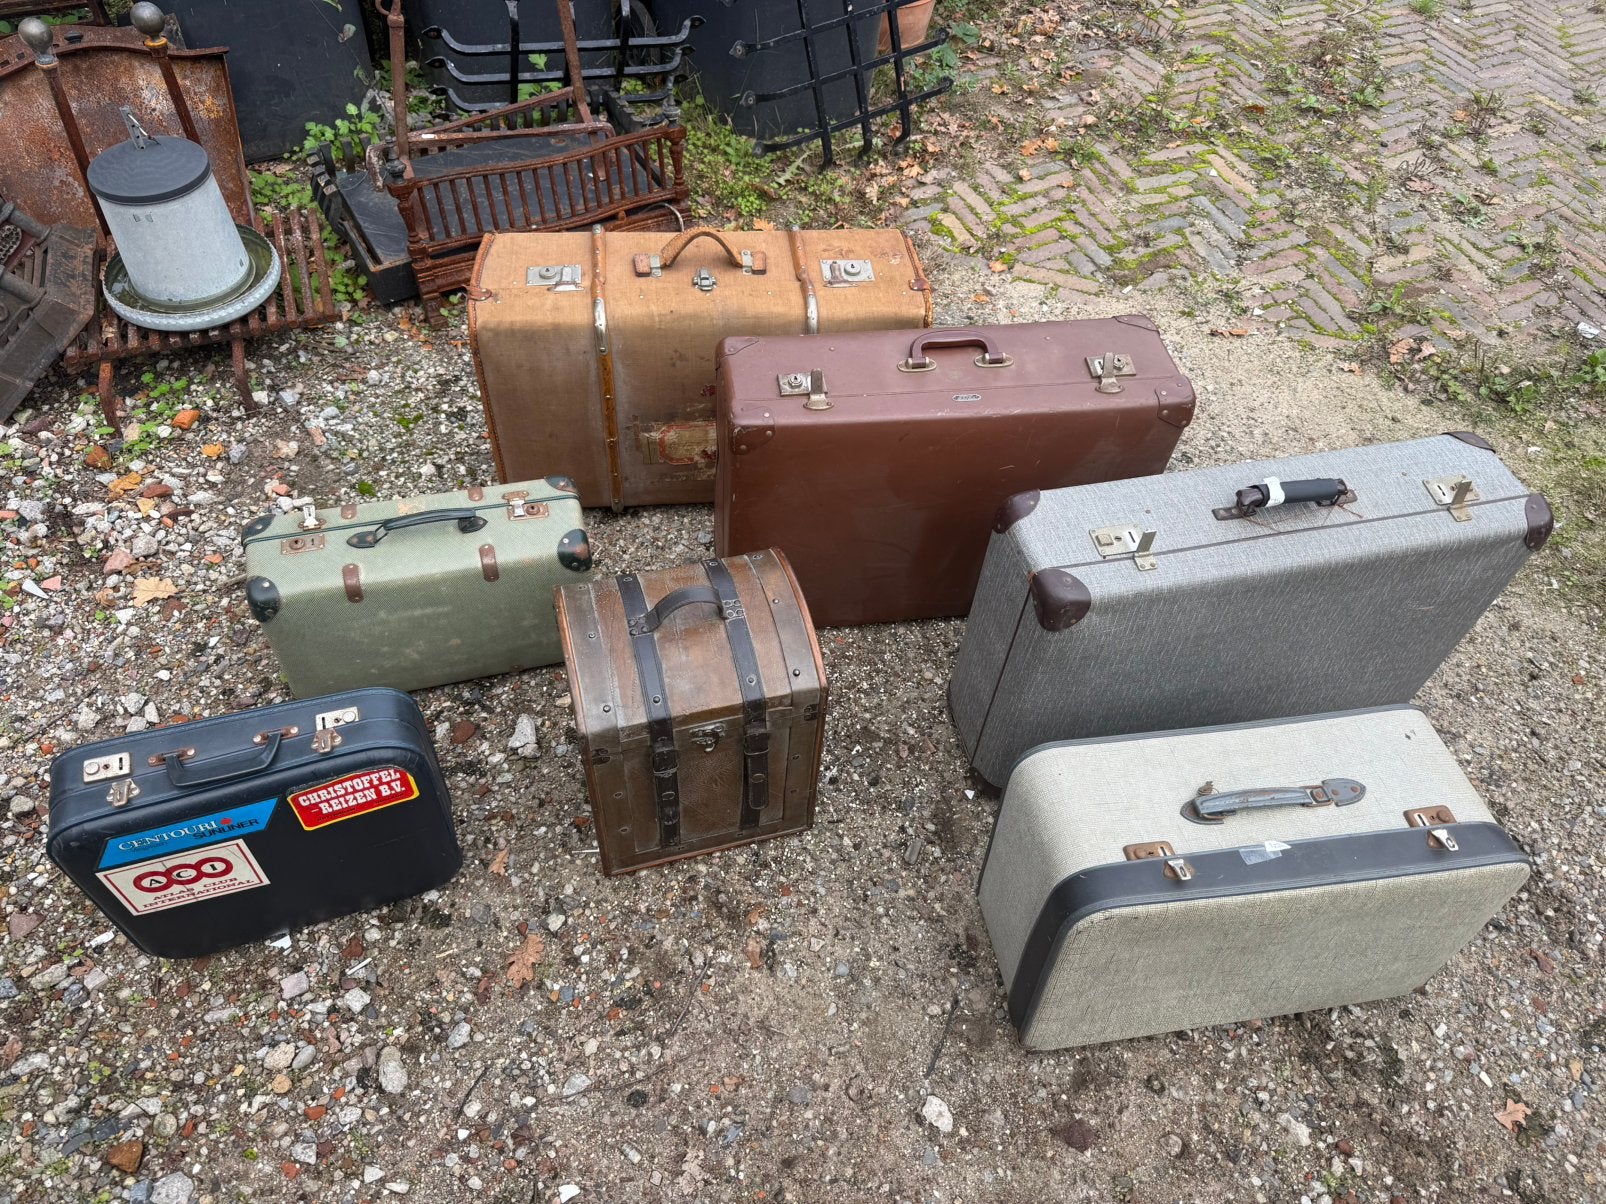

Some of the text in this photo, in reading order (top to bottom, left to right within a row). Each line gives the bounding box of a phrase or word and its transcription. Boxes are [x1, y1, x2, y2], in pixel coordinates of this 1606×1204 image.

[299, 769, 400, 806] CHRISTOFFEL
[379, 780, 406, 797] B.V.
[118, 820, 218, 850] CENTOURI
[192, 818, 259, 840] SUNLINER
[142, 879, 255, 908] INTERNATIONAL
[153, 877, 238, 901] ATLAS CLUB
